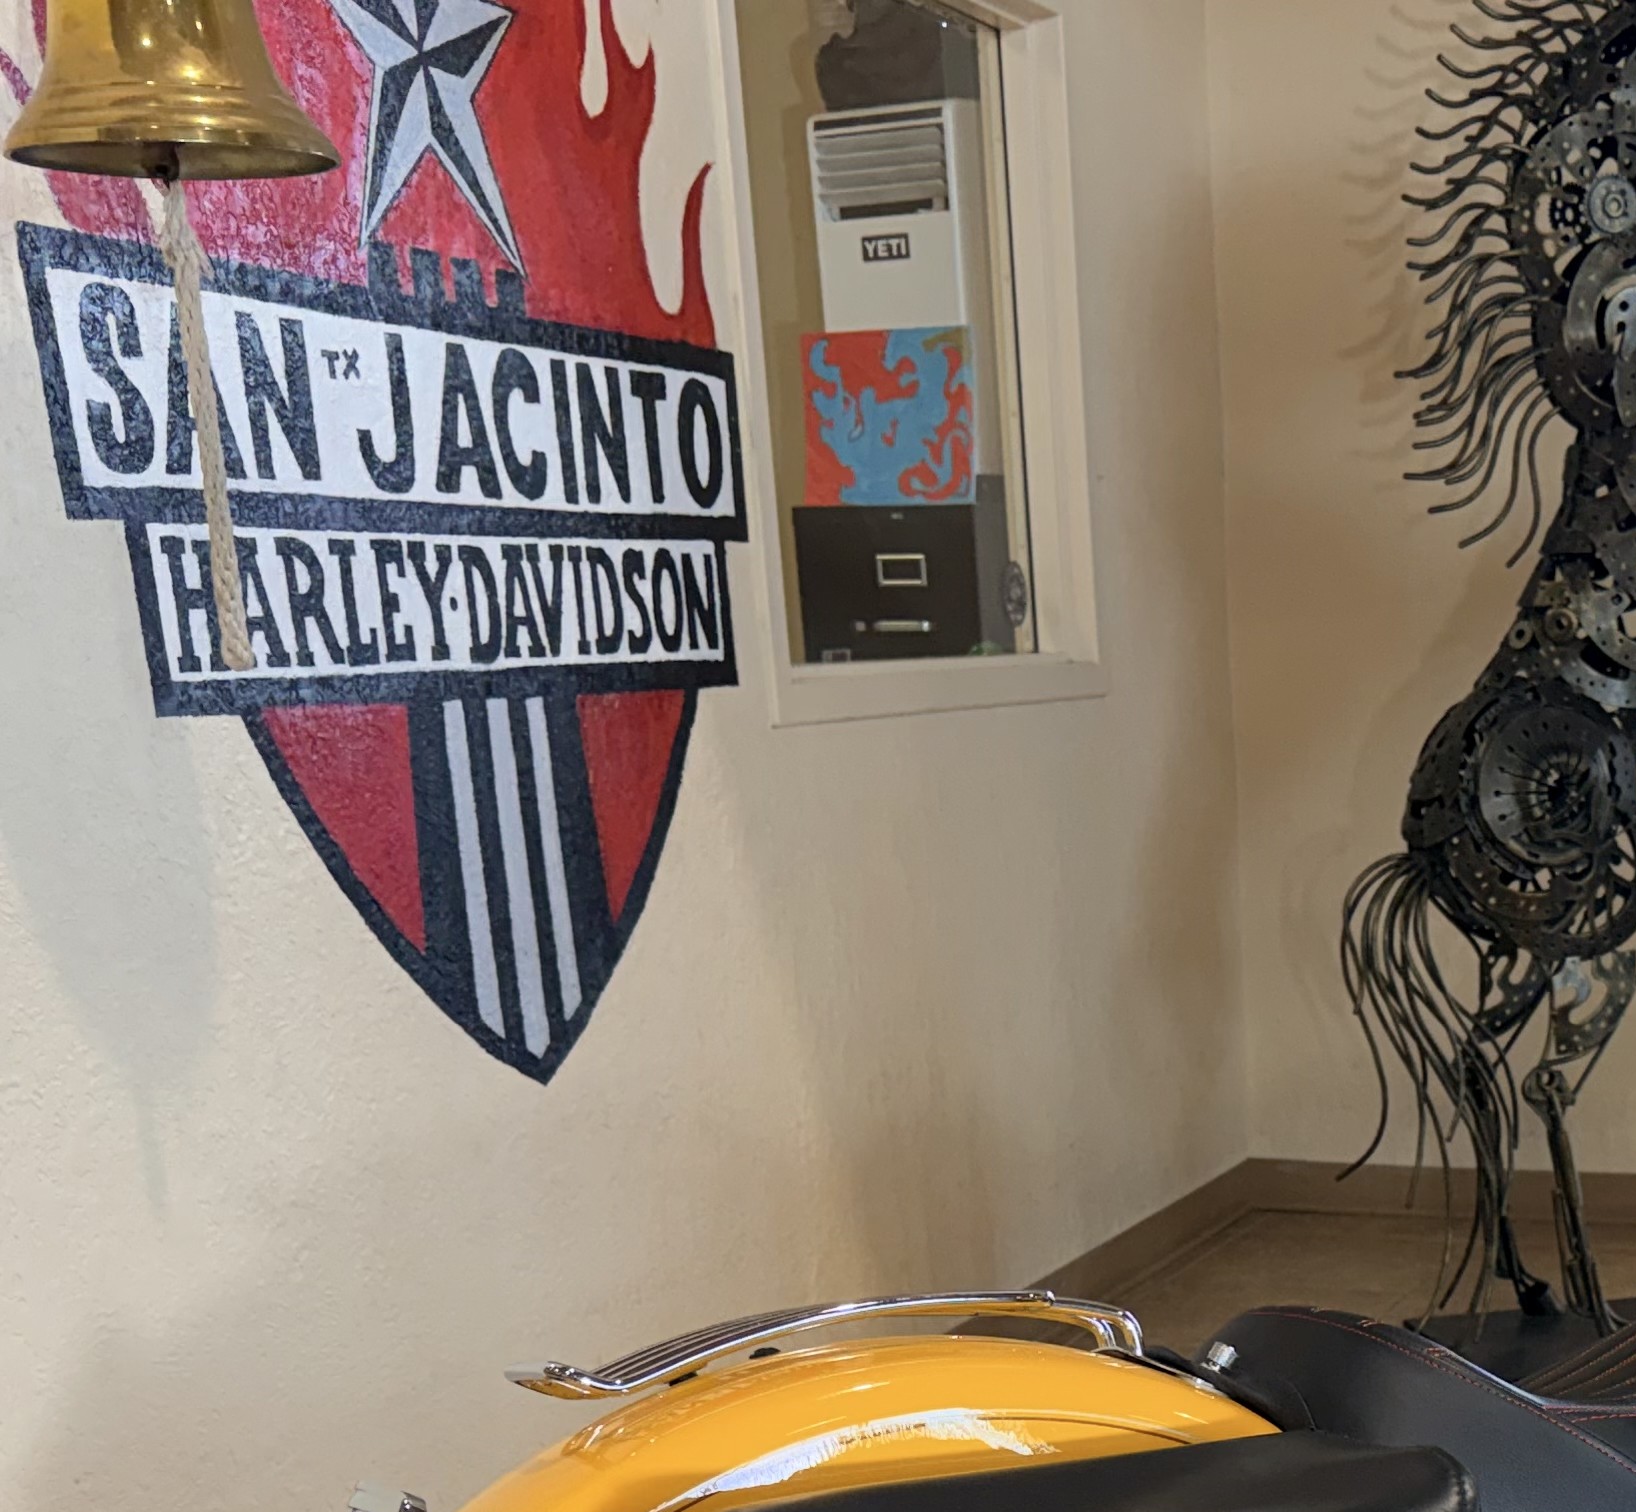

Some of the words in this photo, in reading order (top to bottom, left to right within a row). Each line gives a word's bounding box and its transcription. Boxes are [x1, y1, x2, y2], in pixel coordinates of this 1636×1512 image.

[863, 238, 907, 258] YETI
[79, 282, 322, 481] SAN
[320, 348, 361, 380] TX
[357, 332, 723, 511] JACINTO
